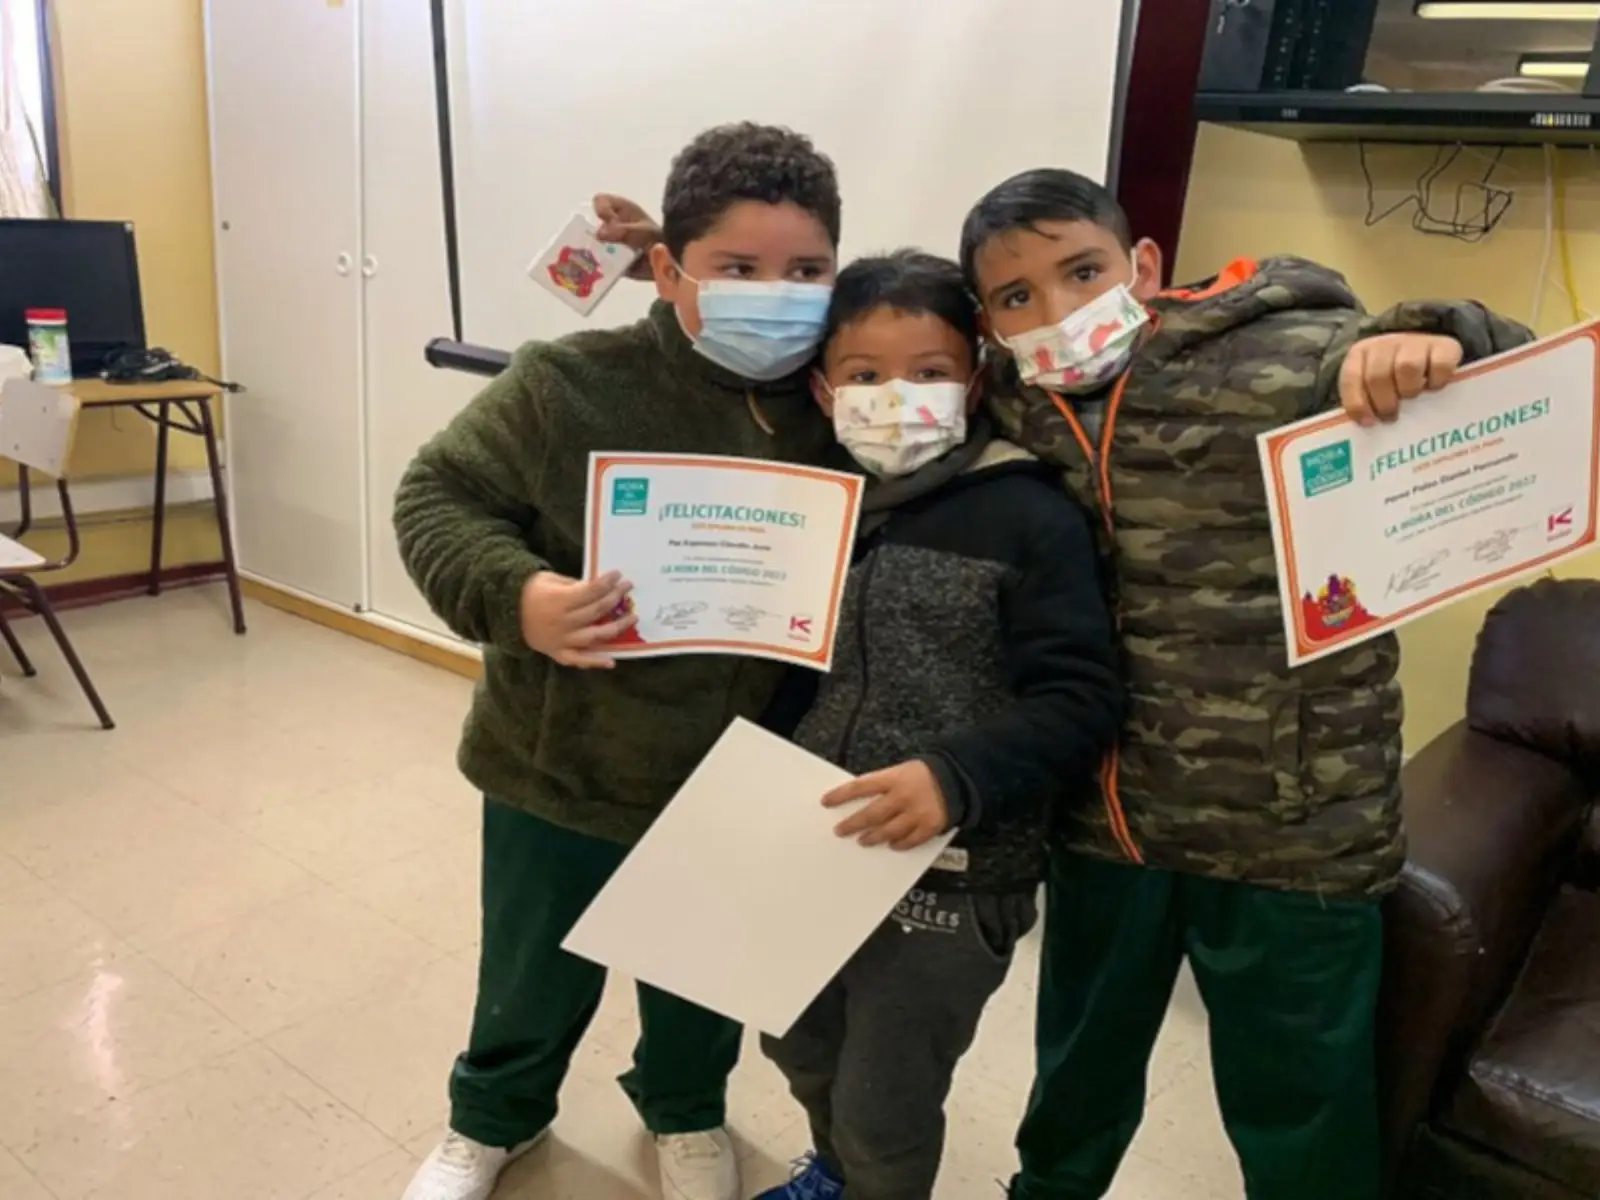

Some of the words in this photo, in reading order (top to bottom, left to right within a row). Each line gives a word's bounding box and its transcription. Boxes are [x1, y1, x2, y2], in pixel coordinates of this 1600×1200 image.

[1369, 397, 1550, 481] ¡FELICITACIONES!
[658, 503, 807, 529] ¡FELICITACIONES!
[1400, 511, 1432, 530] HORA
[1435, 503, 1456, 517] DEL
